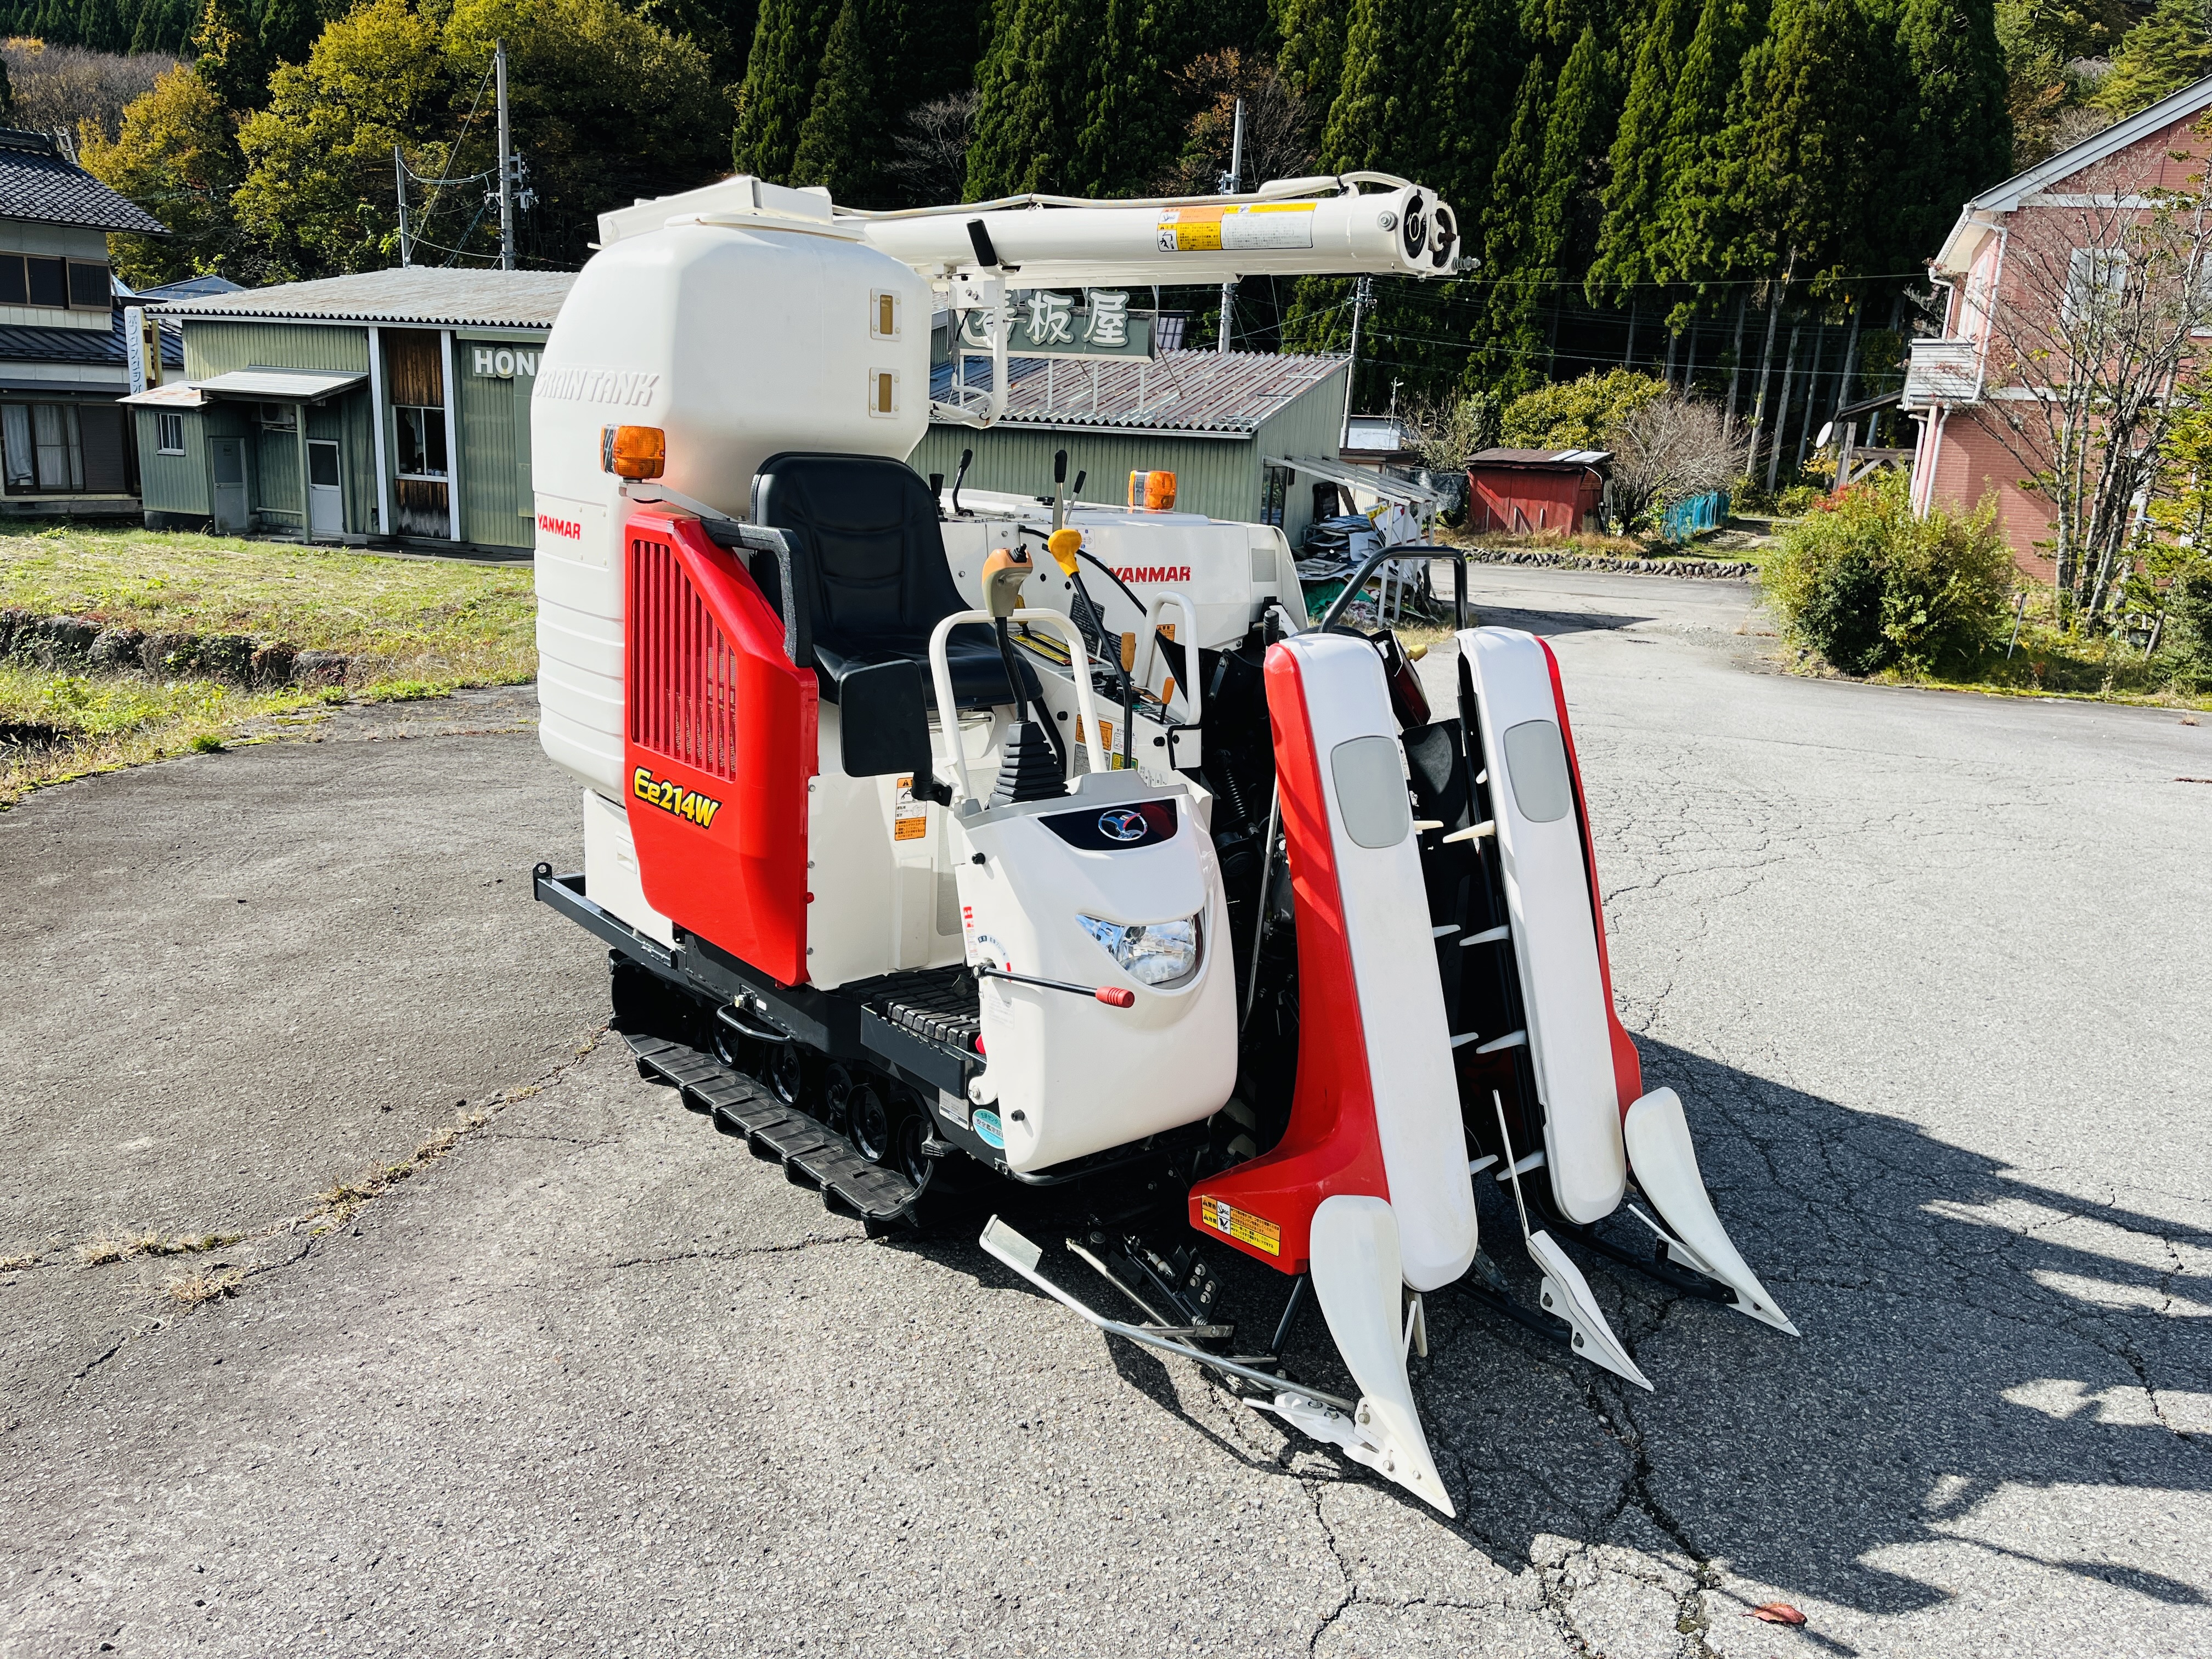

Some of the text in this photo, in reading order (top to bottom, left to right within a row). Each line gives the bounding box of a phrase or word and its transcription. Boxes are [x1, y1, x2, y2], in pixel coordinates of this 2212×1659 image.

[535, 366, 660, 407] GRAIN TANK
[538, 512, 581, 540] YANMAR
[1109, 566, 1191, 583] YANMAR
[634, 767, 720, 828] Ee214W
[977, 1118, 1003, 1138] 安全鑑定証
